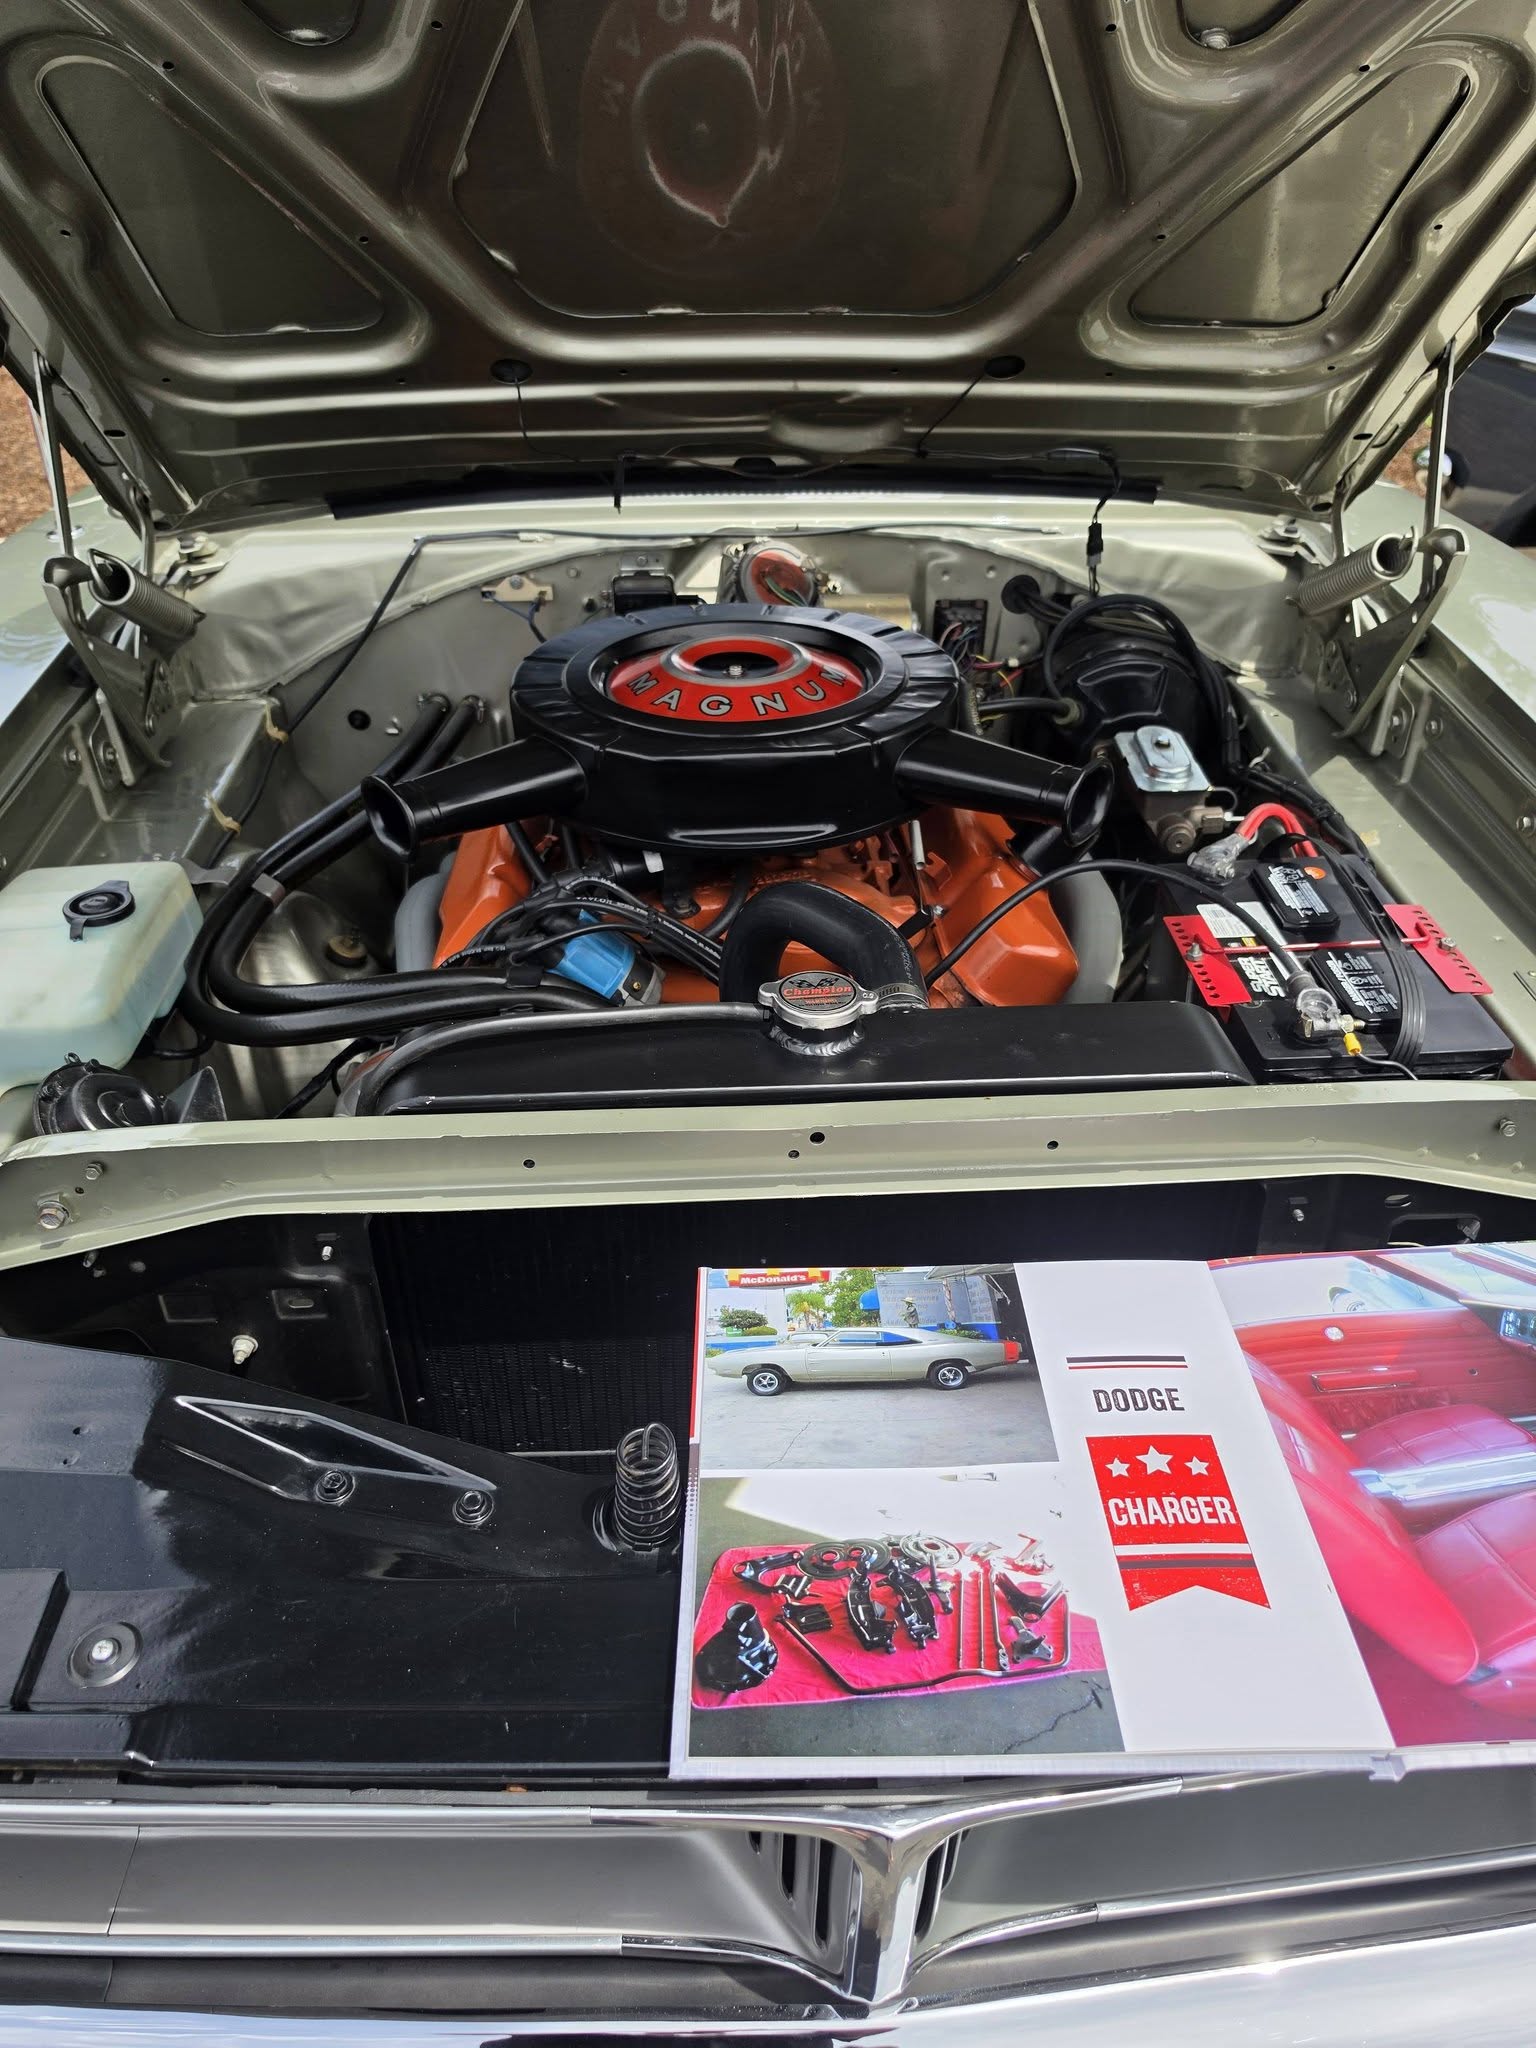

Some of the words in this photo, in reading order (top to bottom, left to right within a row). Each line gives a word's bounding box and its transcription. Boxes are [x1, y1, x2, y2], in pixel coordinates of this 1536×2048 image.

[627, 665, 848, 716] MAGNUM
[1237, 957, 1263, 993] SUPER
[1249, 956, 1286, 998] START
[783, 985, 852, 996] Champion
[740, 1274, 807, 1285] McDonald's
[1092, 1388, 1185, 1413] DODGE
[1107, 1496, 1237, 1526] CHARGER
